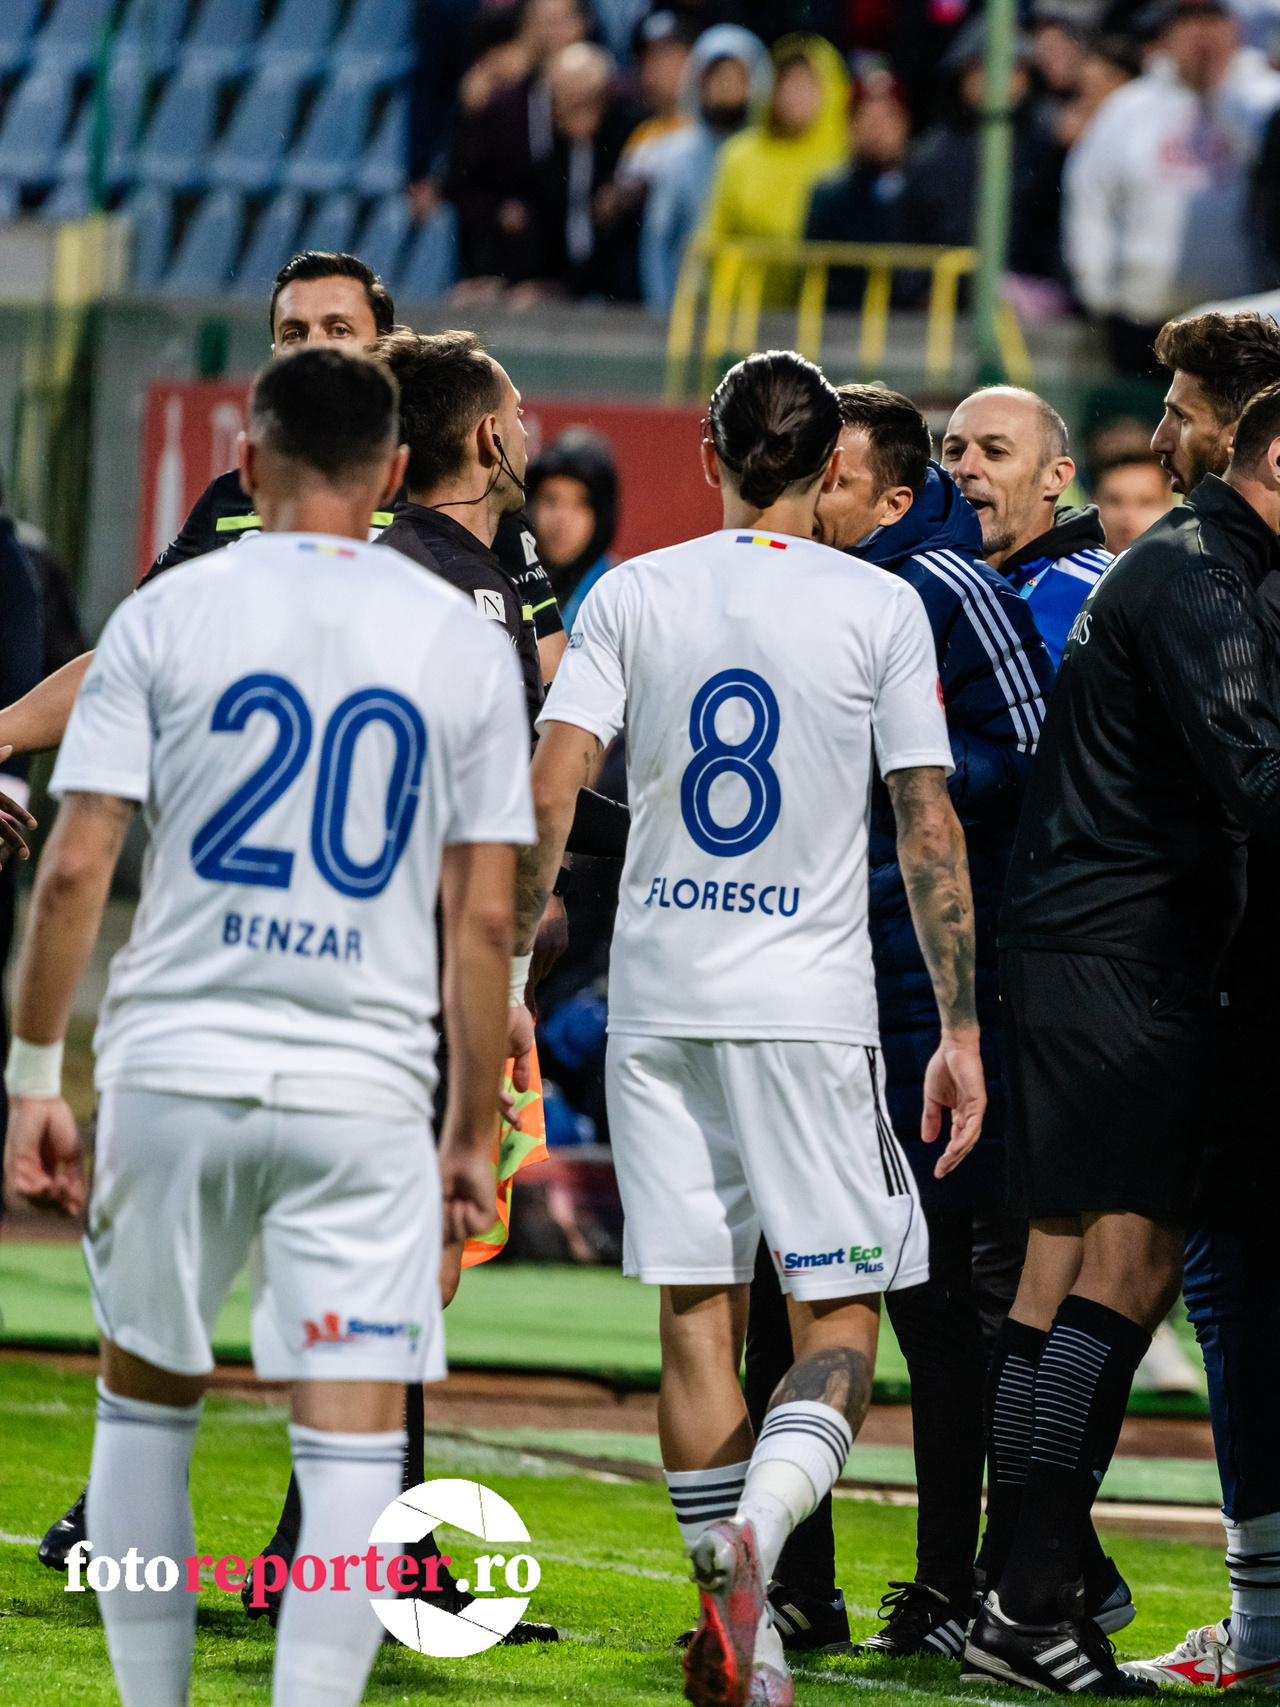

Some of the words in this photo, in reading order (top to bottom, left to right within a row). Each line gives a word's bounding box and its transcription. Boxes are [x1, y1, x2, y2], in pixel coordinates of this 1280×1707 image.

[681, 668, 781, 857] 8
[190, 672, 427, 898] 20
[645, 877, 800, 917] FLORESCU
[223, 913, 362, 961] BENZAR
[785, 1248, 845, 1269] Smart
[849, 1246, 883, 1262] Eco
[855, 1262, 884, 1274] Plus
